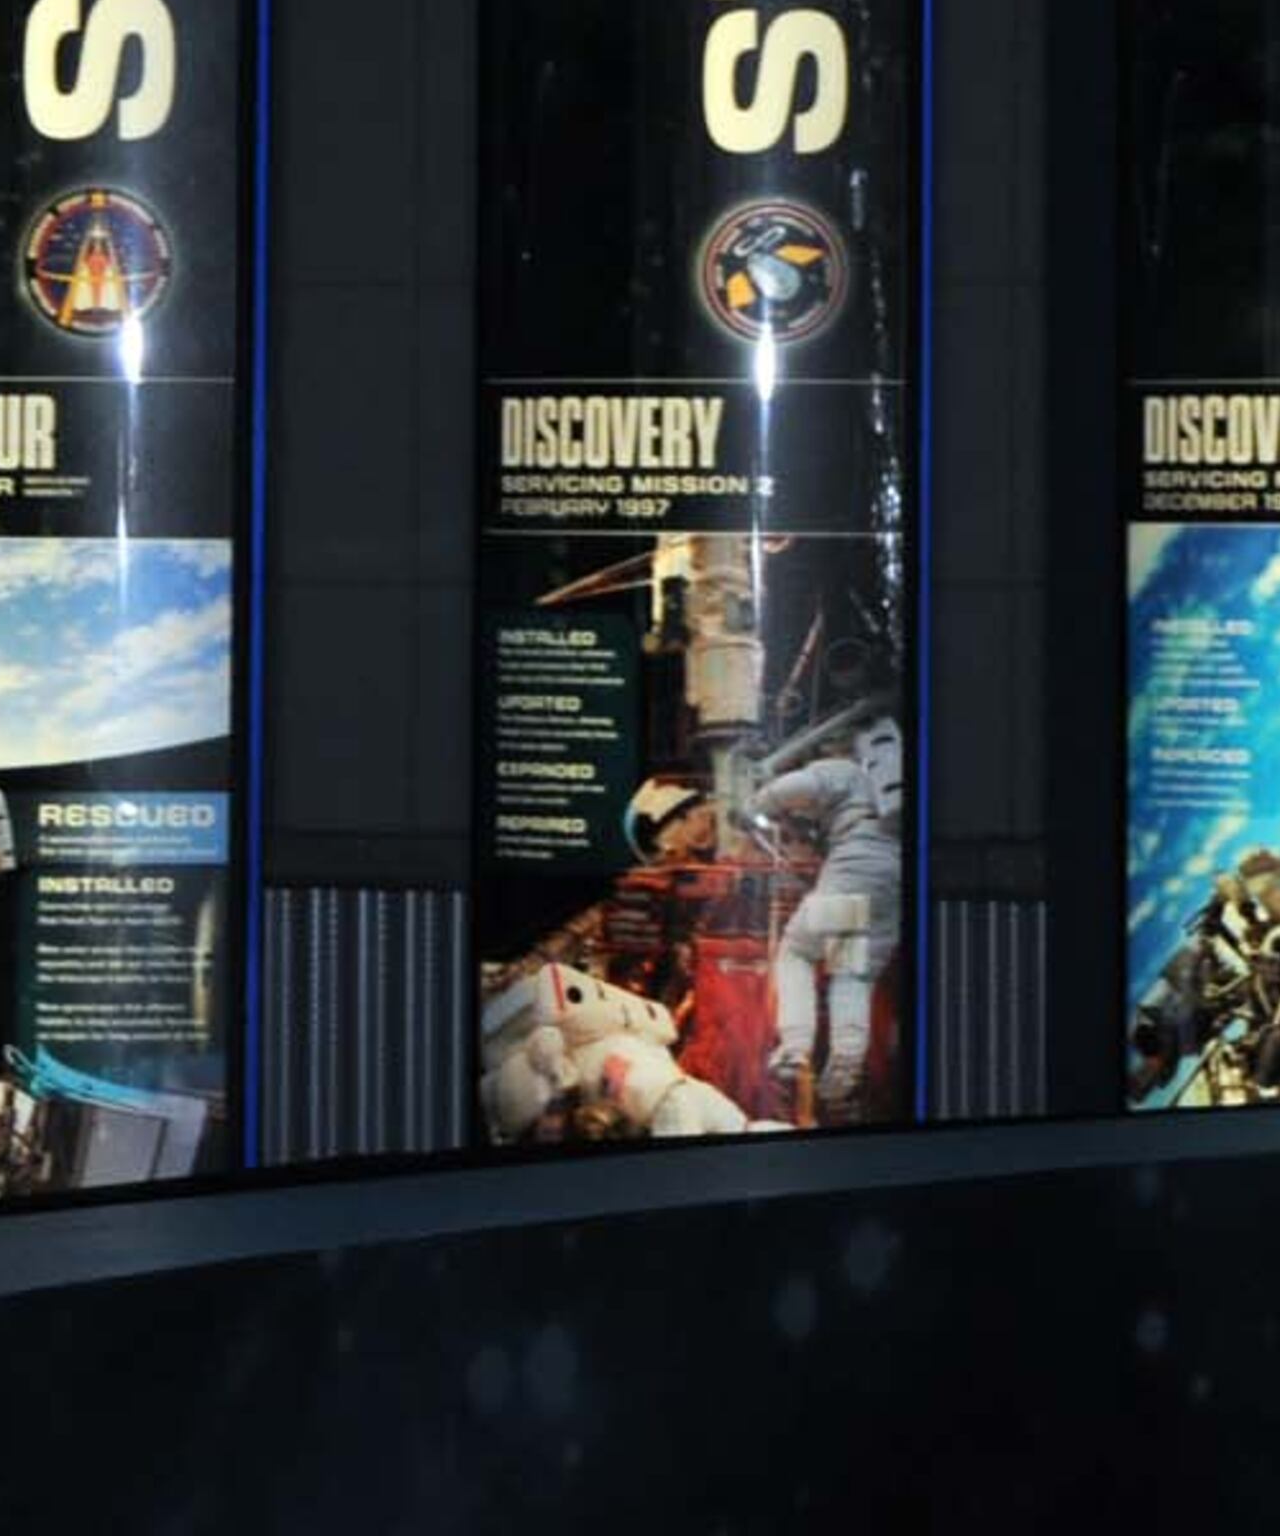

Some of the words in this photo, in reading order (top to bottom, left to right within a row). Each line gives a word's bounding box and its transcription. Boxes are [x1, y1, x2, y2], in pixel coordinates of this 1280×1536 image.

[502, 397, 723, 468] DISCOVERY
[501, 475, 624, 494] SERVICING
[631, 475, 749, 495] MISSION
[755, 477, 774, 496] 2
[1143, 471, 1267, 489] SERVICING
[501, 498, 610, 515] FEBRUARY
[616, 498, 671, 516] 1997
[1143, 493, 1257, 510] DECEMBER
[37, 803, 215, 827] RESCUED
[37, 877, 174, 894] INSTALLED
